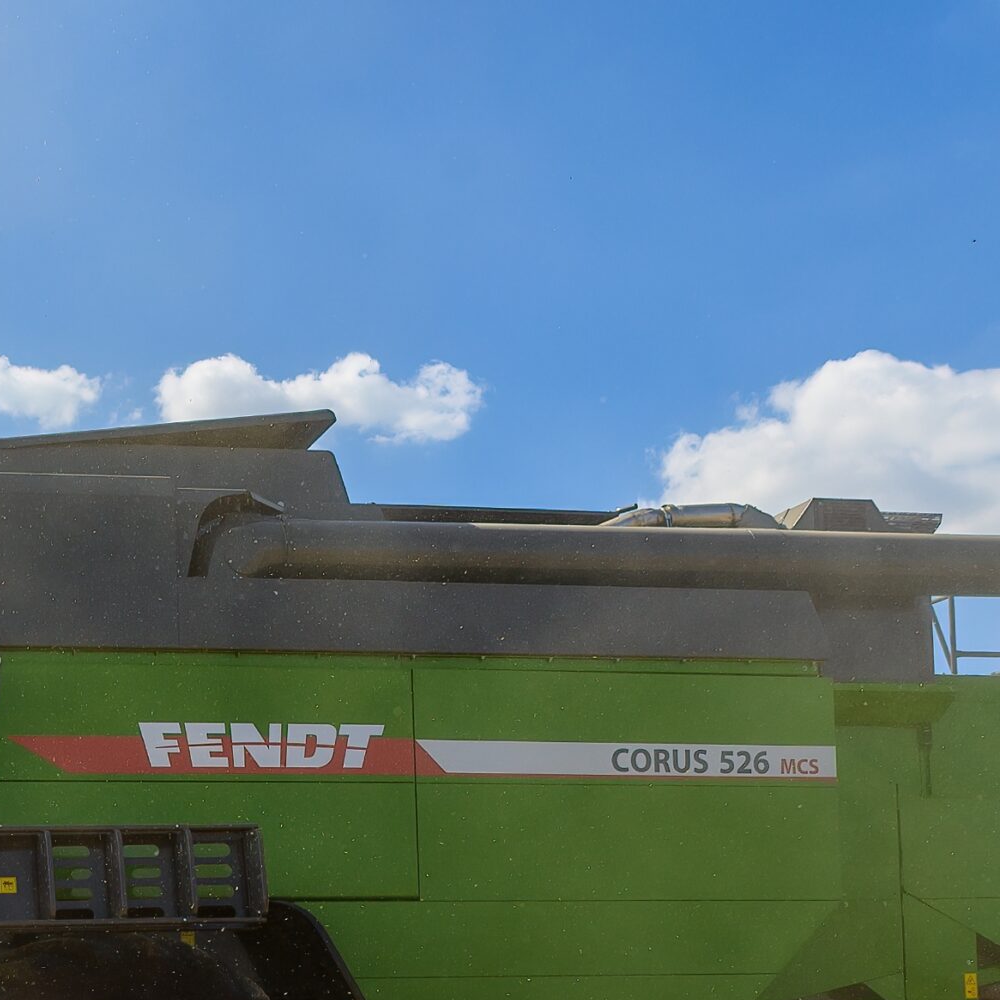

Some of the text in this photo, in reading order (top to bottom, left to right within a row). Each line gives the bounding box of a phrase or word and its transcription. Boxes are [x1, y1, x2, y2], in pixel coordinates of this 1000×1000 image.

[138, 722, 385, 769] FENDT
[611, 748, 820, 775] CORUS 526 MCS
